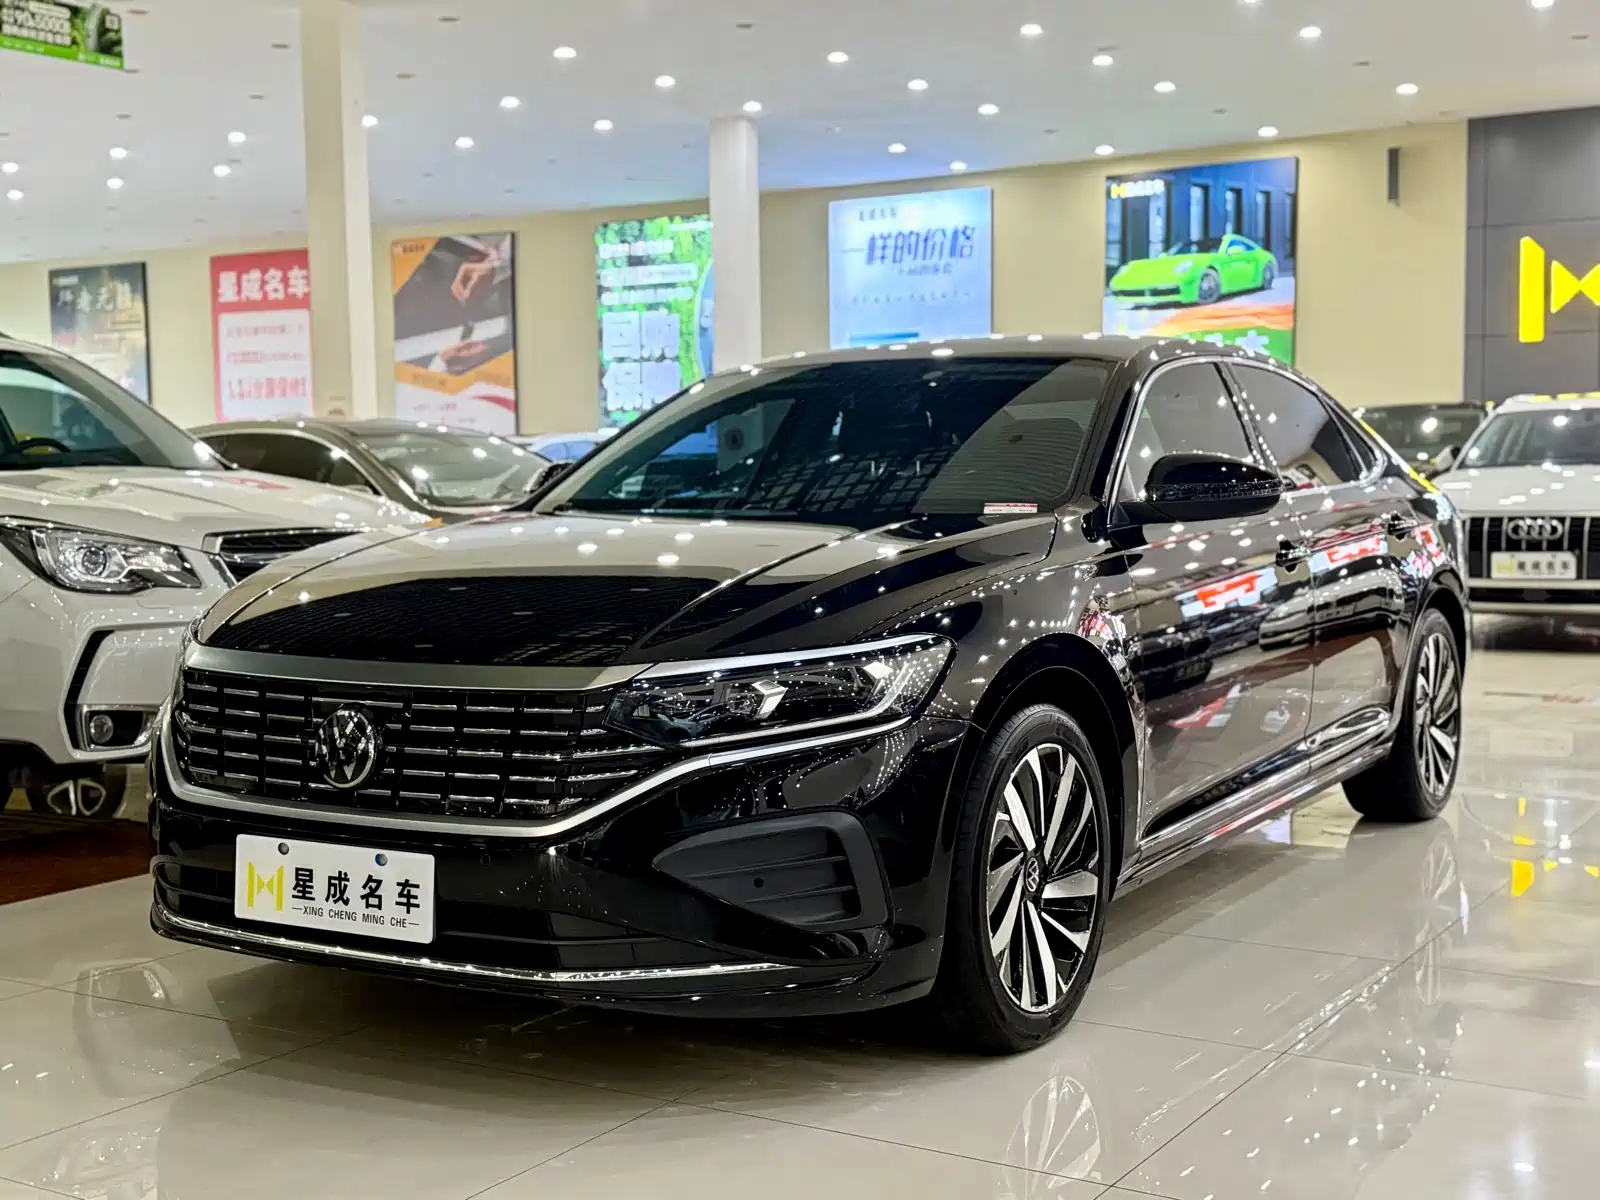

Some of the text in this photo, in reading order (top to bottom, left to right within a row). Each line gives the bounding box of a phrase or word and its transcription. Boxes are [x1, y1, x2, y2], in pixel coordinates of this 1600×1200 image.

[217, 266, 309, 303] 星成名车
[291, 866, 421, 915] 星成名车
[302, 905, 407, 928] XING CHENG MING CHE
